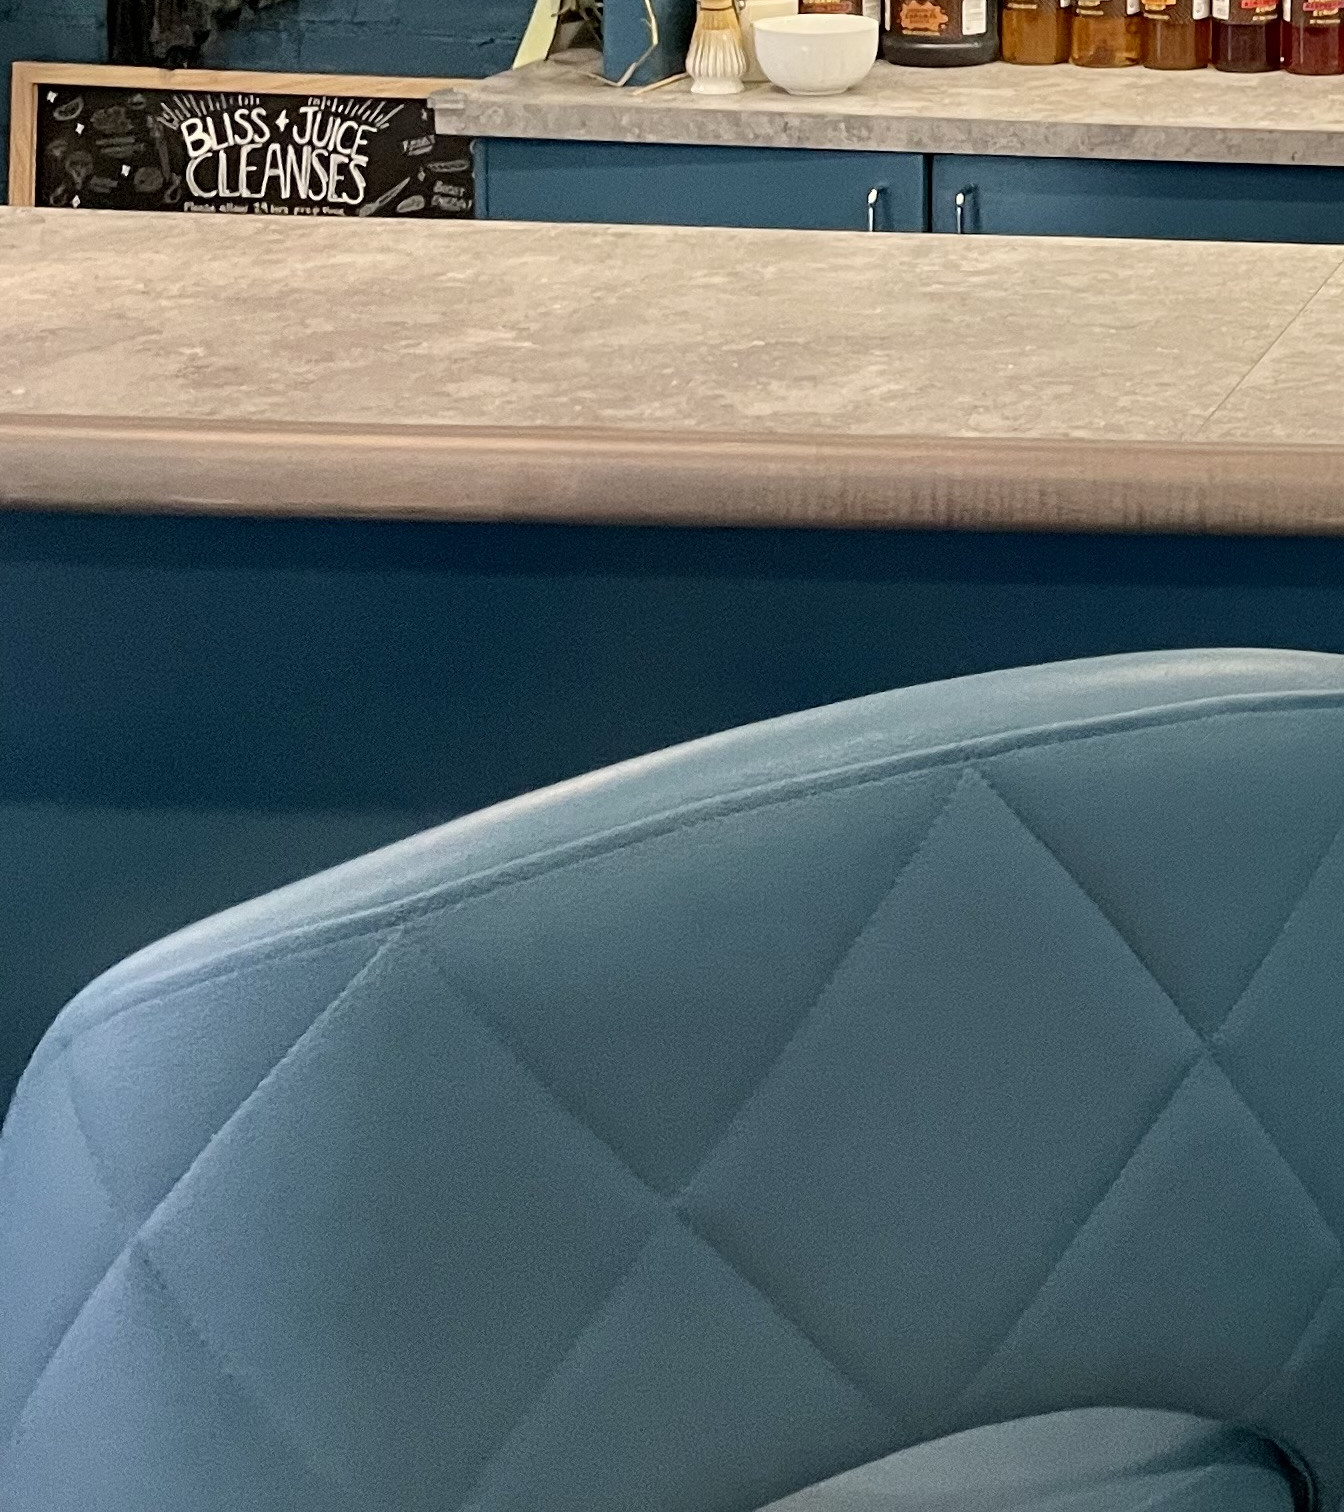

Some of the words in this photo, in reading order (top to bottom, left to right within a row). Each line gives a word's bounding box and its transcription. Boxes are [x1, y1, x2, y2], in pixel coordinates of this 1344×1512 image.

[180, 107, 270, 159] BLISS
[292, 106, 378, 162] JUICE
[185, 143, 369, 205] CLEANSES
